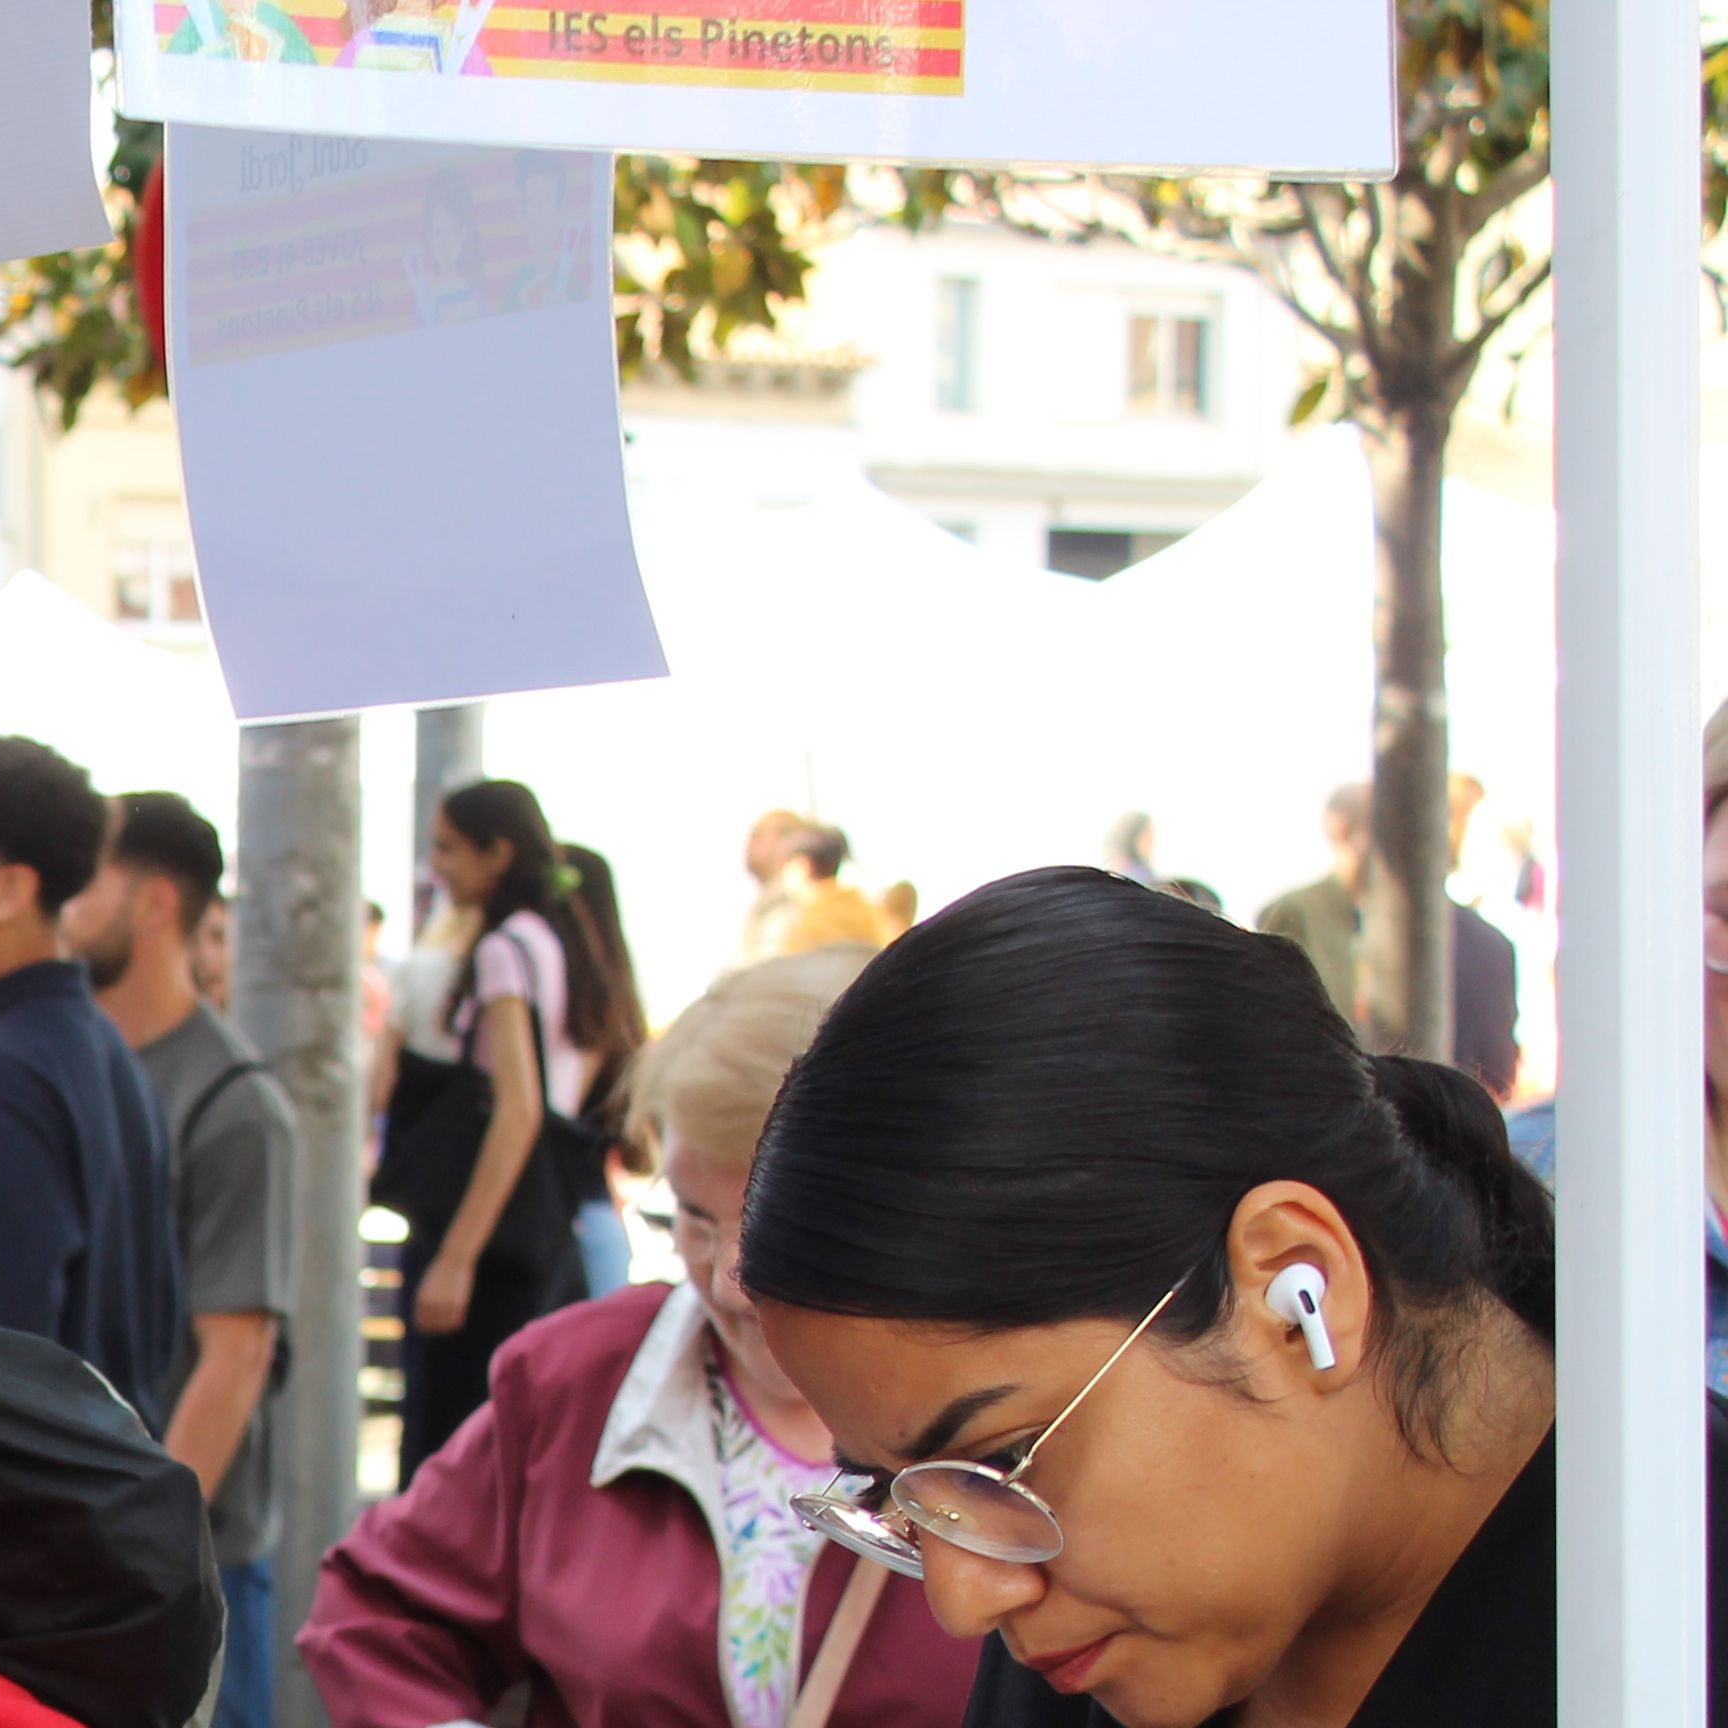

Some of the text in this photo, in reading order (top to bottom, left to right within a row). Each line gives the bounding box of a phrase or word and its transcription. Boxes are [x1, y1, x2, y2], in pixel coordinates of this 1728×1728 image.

[544, 9, 897, 69] IES els Pinetons
